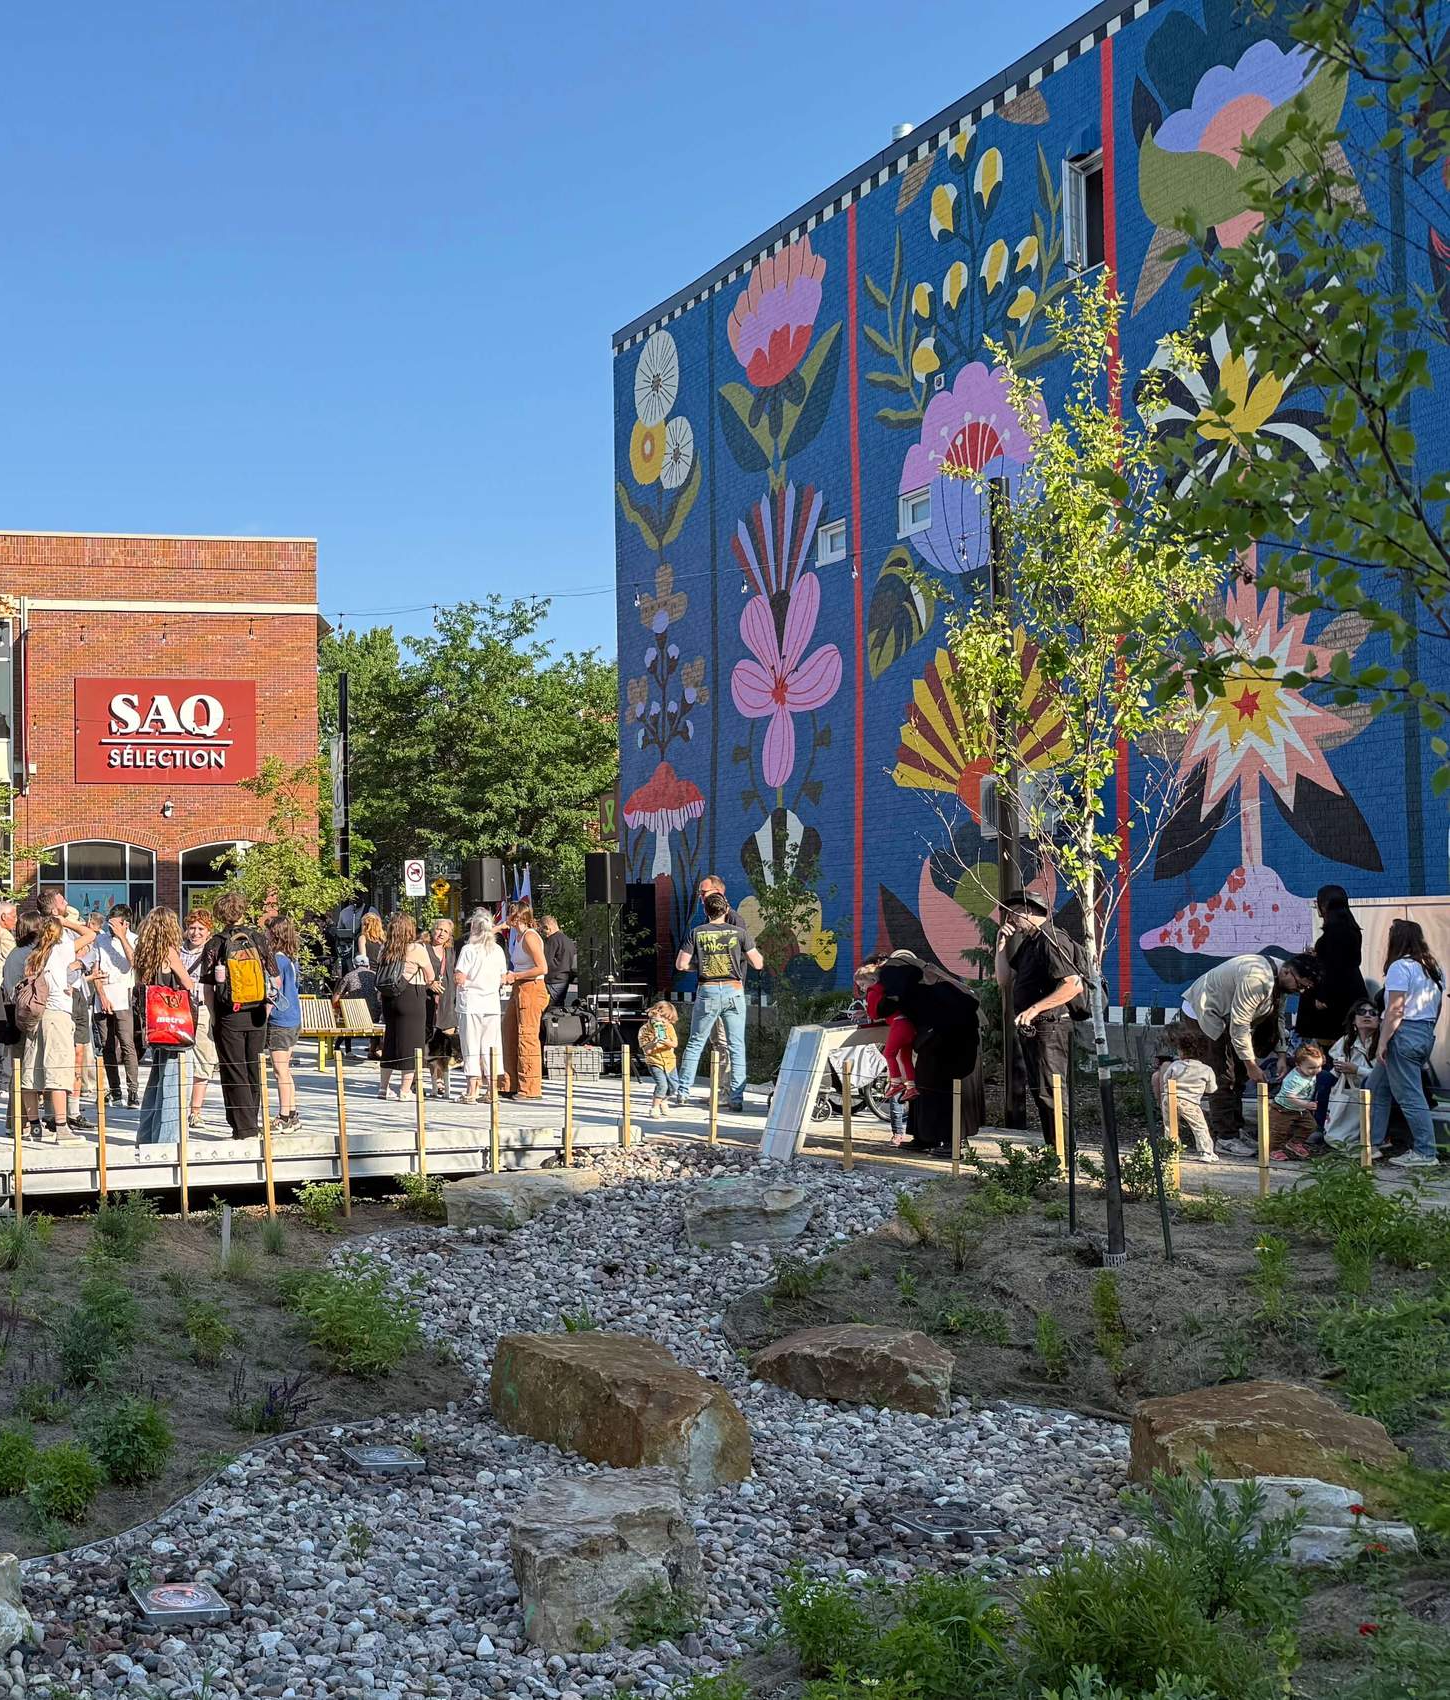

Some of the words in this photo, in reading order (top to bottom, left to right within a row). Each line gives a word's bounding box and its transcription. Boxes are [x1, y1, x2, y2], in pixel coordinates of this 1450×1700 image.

[109, 693, 225, 737] SAQ
[109, 744, 226, 768] SÉLECTION
[156, 1016, 186, 1025] metro
